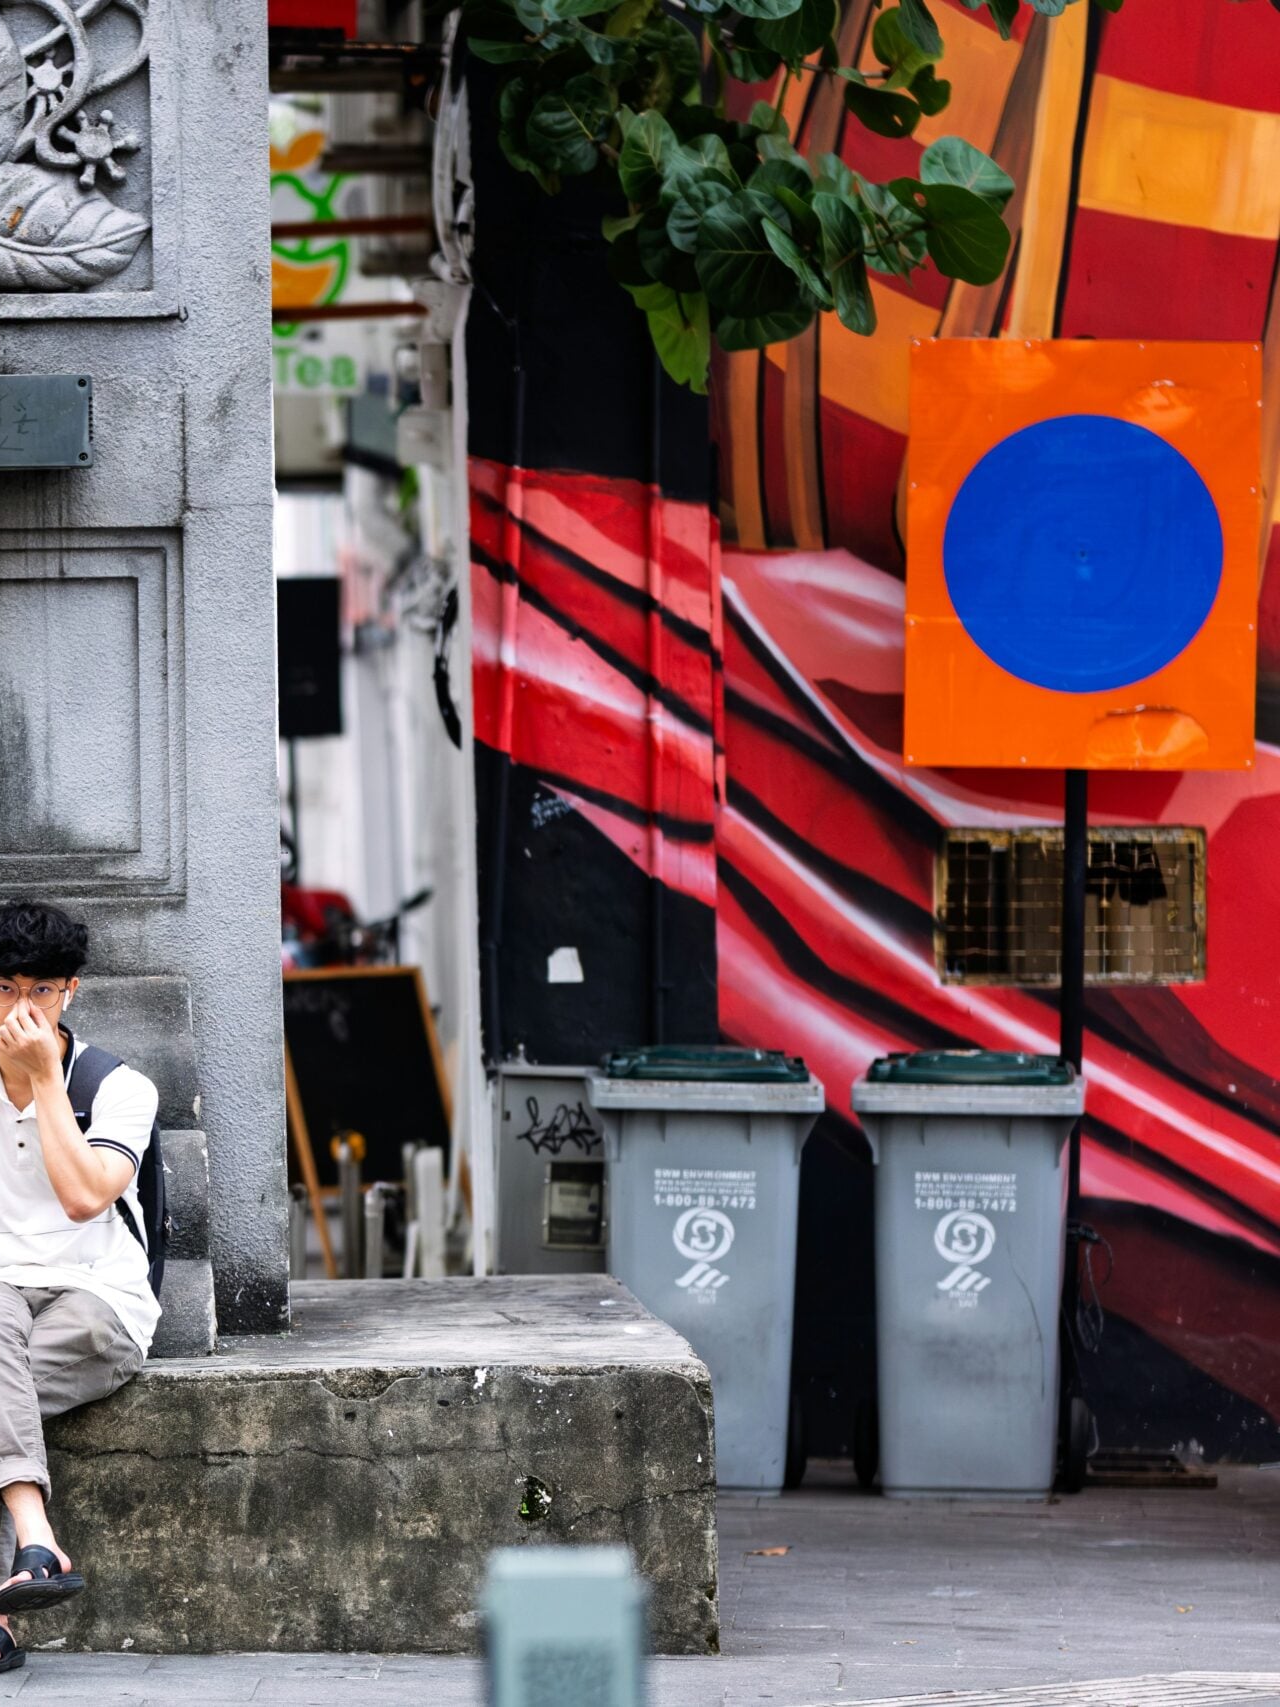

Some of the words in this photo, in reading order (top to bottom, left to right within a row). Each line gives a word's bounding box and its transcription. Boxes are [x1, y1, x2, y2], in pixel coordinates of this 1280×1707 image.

[272, 347, 357, 387] Tea
[683, 1169, 756, 1180] ENVIRONMENT
[943, 1172, 1017, 1183] ENVIRONMENT
[654, 1195, 756, 1208] 1-800-88-7472
[915, 1198, 1016, 1211] 1-800-88-7472
